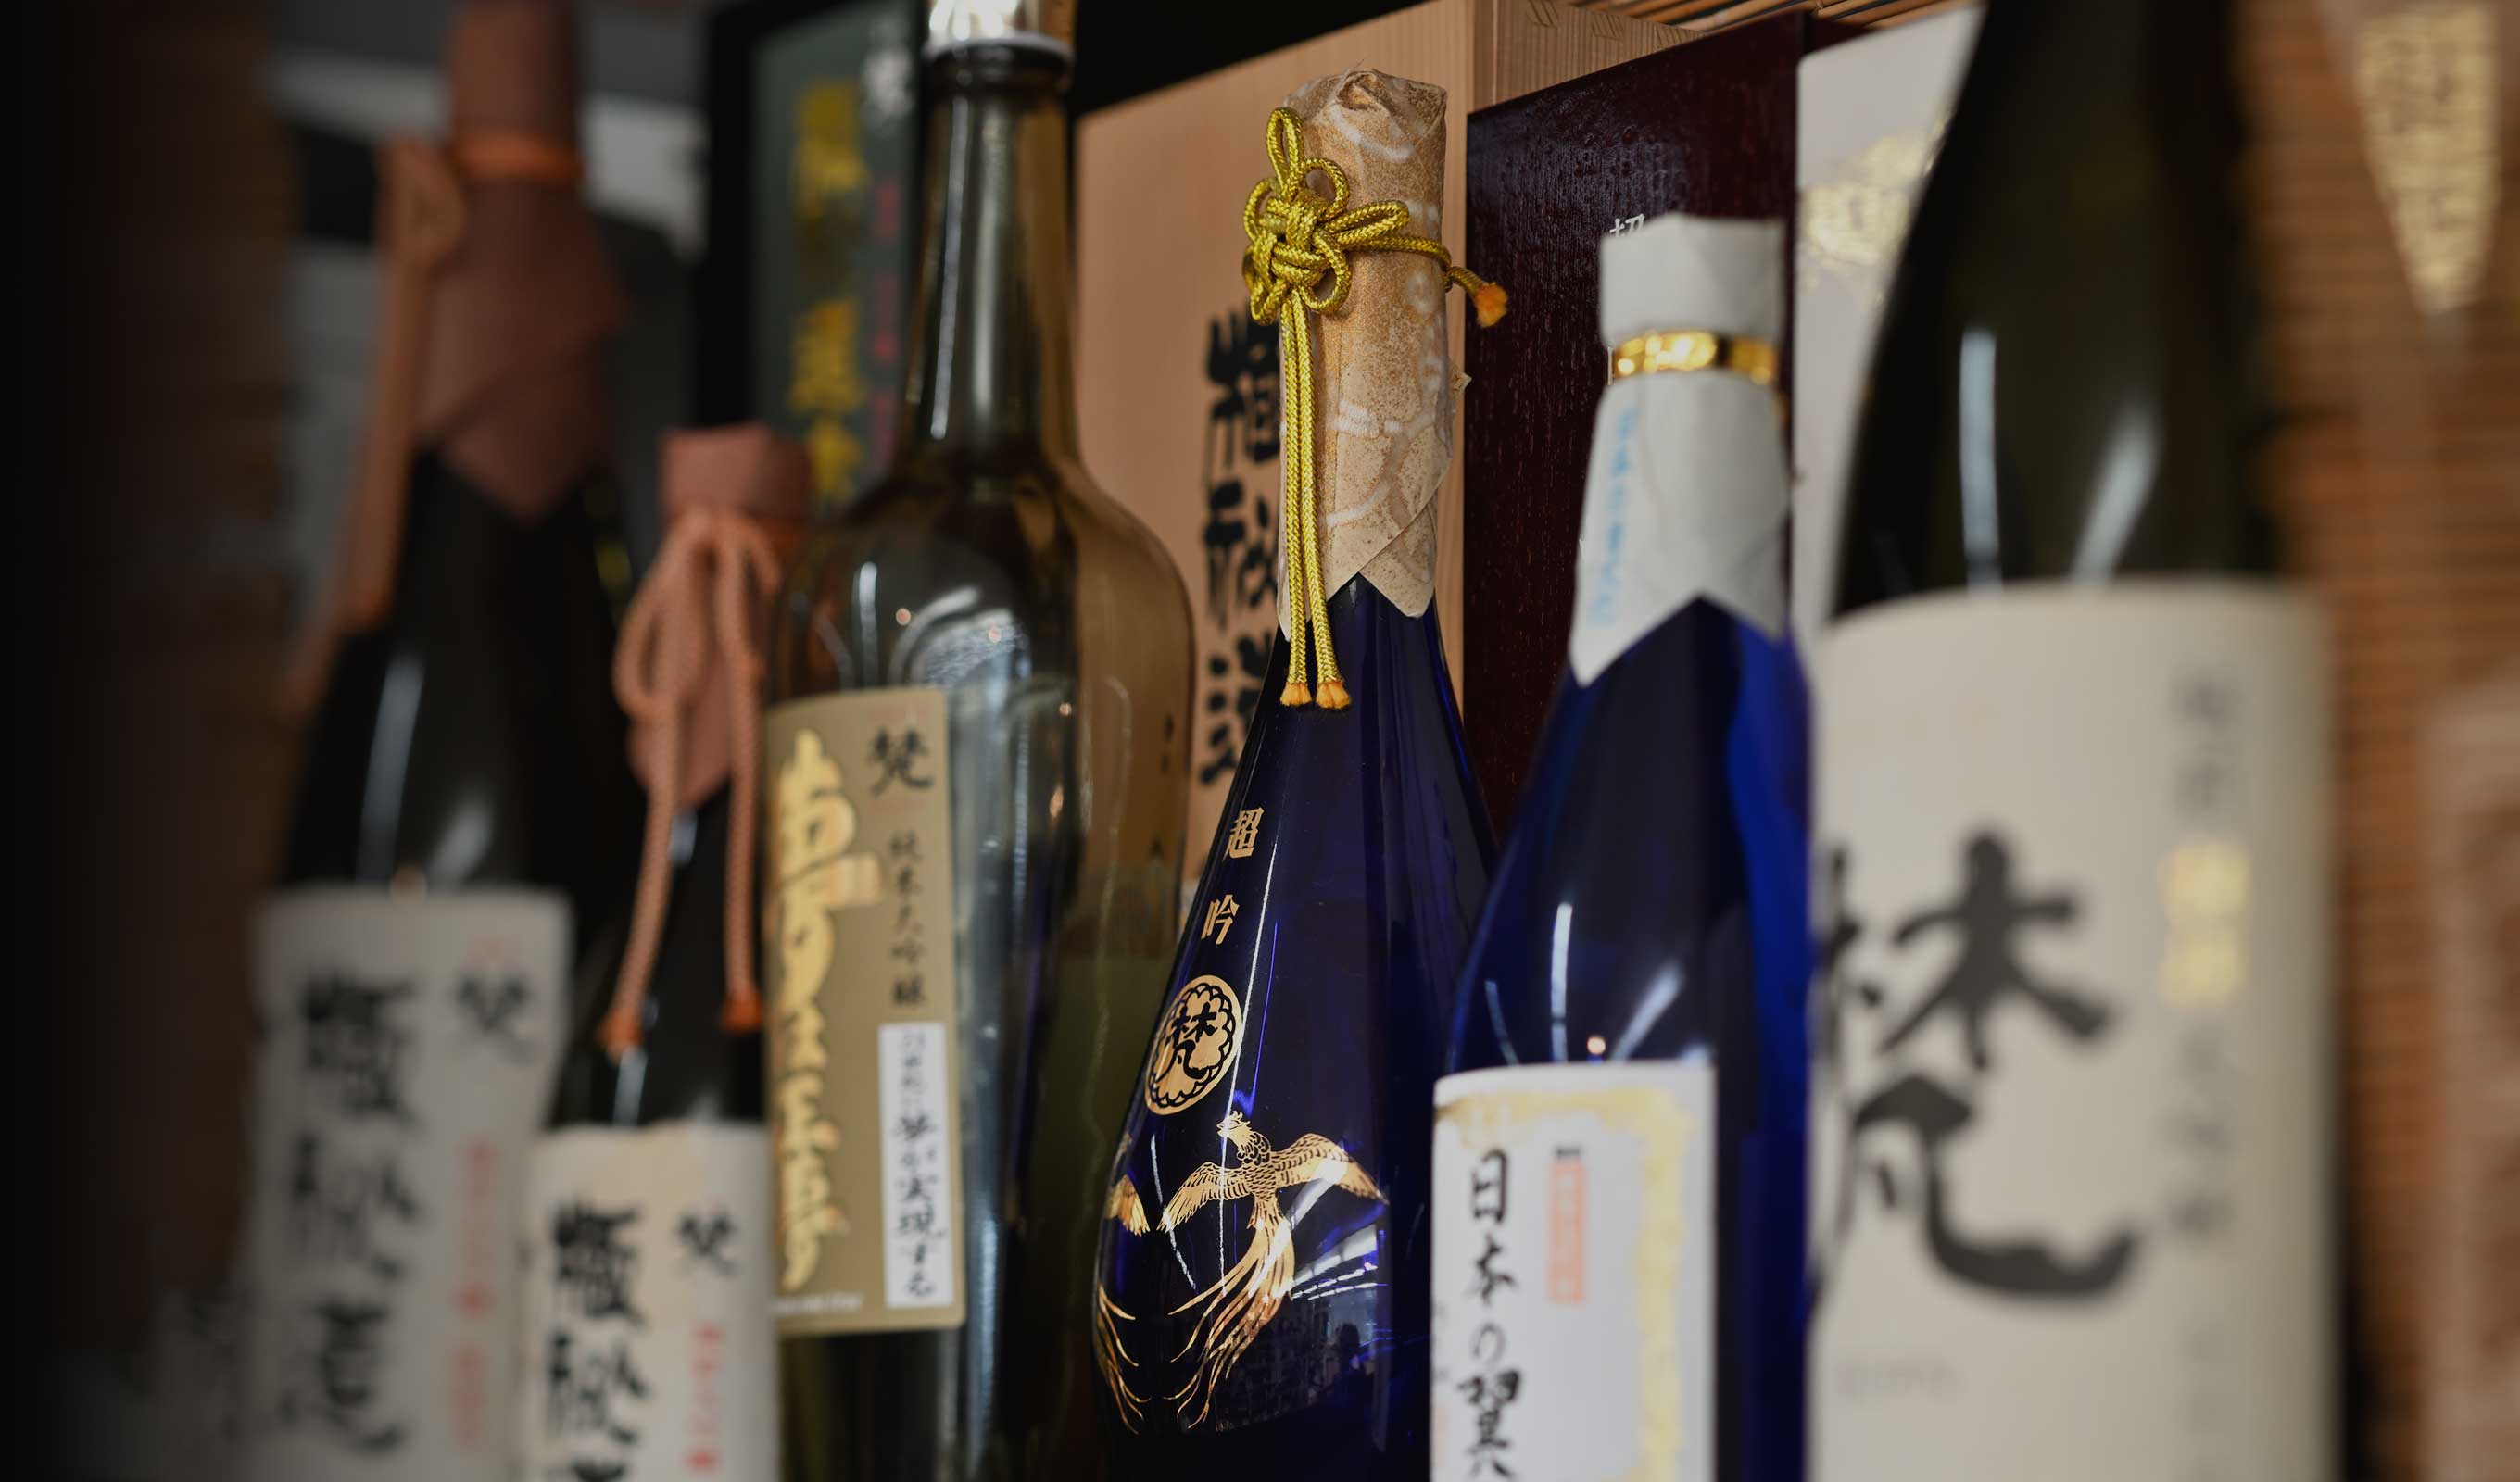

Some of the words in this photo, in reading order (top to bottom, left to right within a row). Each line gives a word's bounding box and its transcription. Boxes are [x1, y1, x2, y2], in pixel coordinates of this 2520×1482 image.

[1201, 807, 1264, 946] 超吟
[1158, 1002, 1241, 1080] 梵
[1457, 1149, 1521, 1480] 日本の翼
